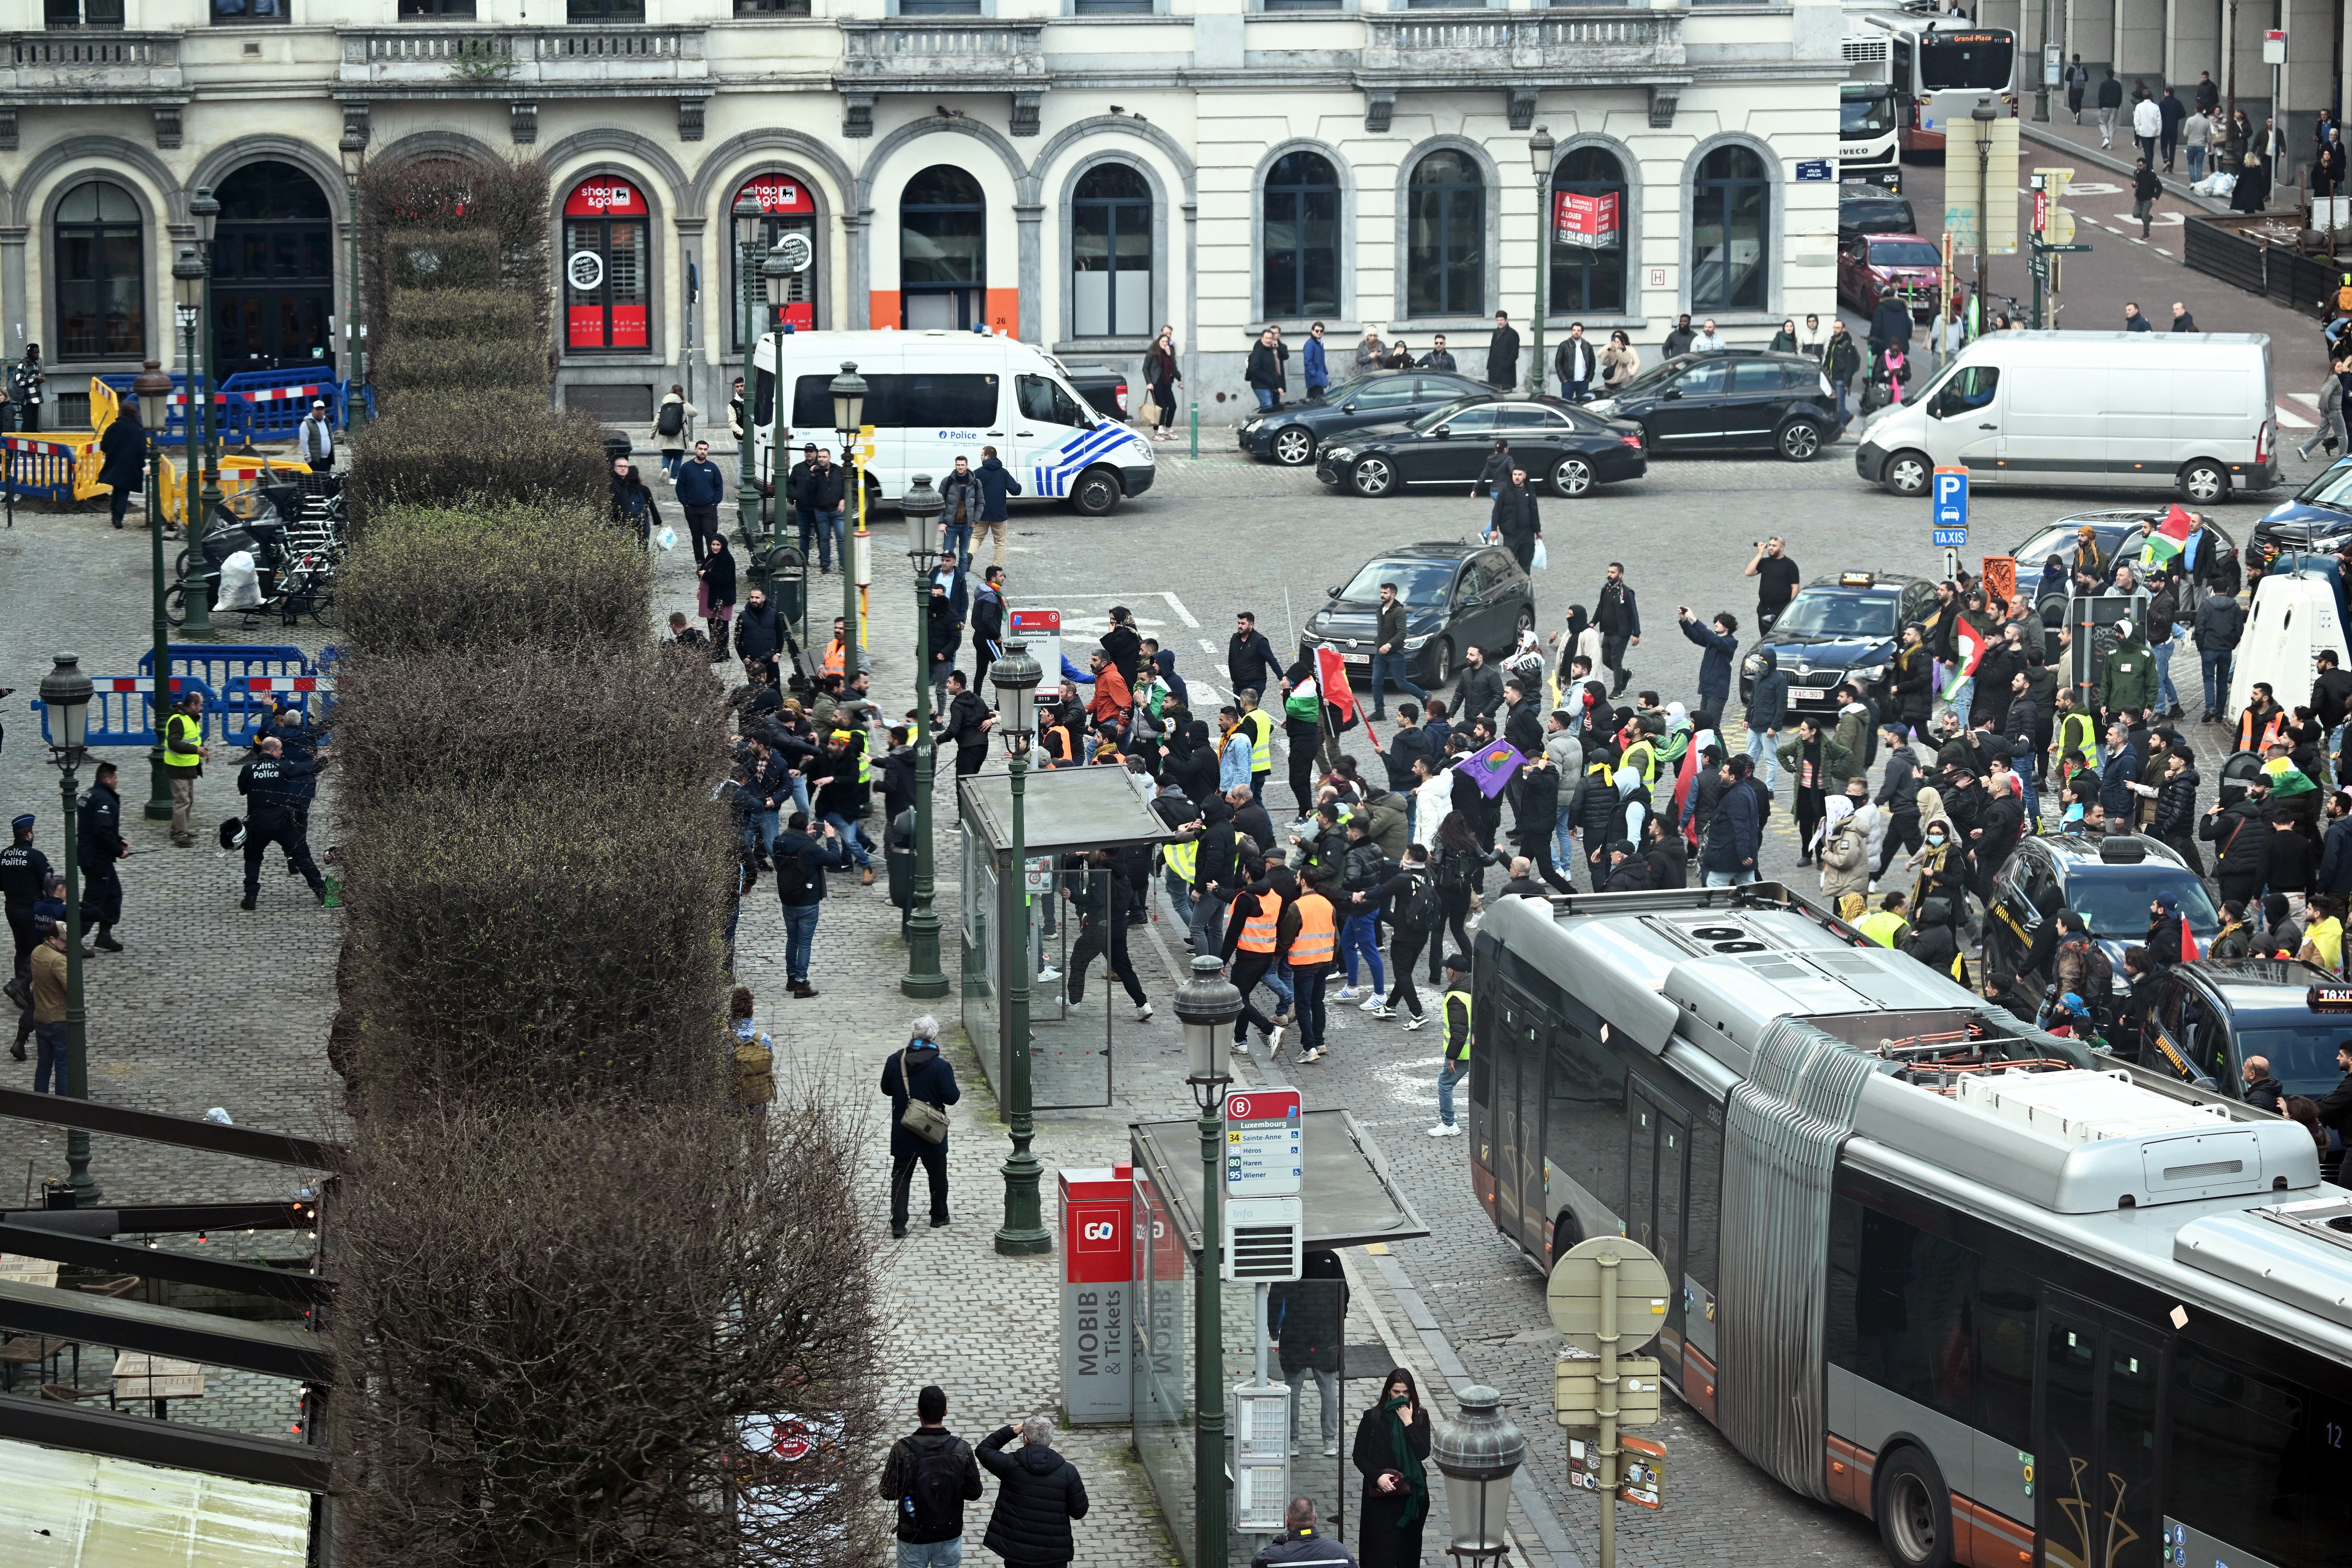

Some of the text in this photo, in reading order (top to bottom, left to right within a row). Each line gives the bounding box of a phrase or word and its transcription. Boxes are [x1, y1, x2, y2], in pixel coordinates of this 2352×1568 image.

[582, 186, 611, 197] shop
[588, 197, 611, 208] &go
[1566, 211, 1582, 220] LOUER
[1601, 213, 1609, 221] LOUER
[1567, 220, 1581, 229] HUUR
[1560, 229, 1566, 238] 02
[1567, 230, 1576, 240] 514
[1576, 232, 1584, 242] 40
[1584, 234, 1592, 244] 00
[1610, 231, 1614, 239] 00
[1655, 272, 1661, 282] H
[950, 431, 977, 439] Police
[1941, 477, 1960, 504] P
[1935, 532, 1964, 543] TAXIS
[253, 770, 279, 779] Police
[4, 848, 28, 857] Police
[1, 858, 27, 866] Politie
[2322, 990, 2349, 999] TAXI
[1236, 1102, 1245, 1113] B
[1708, 1103, 1722, 1125] 9303
[1229, 1171, 1240, 1179] 95
[1233, 1209, 1253, 1219] Info
[1085, 1222, 1113, 1240] GO
[1078, 1292, 1098, 1376] MOBIB
[1104, 1290, 1121, 1375] & Tickets
[2326, 1422, 2342, 1449] 12
